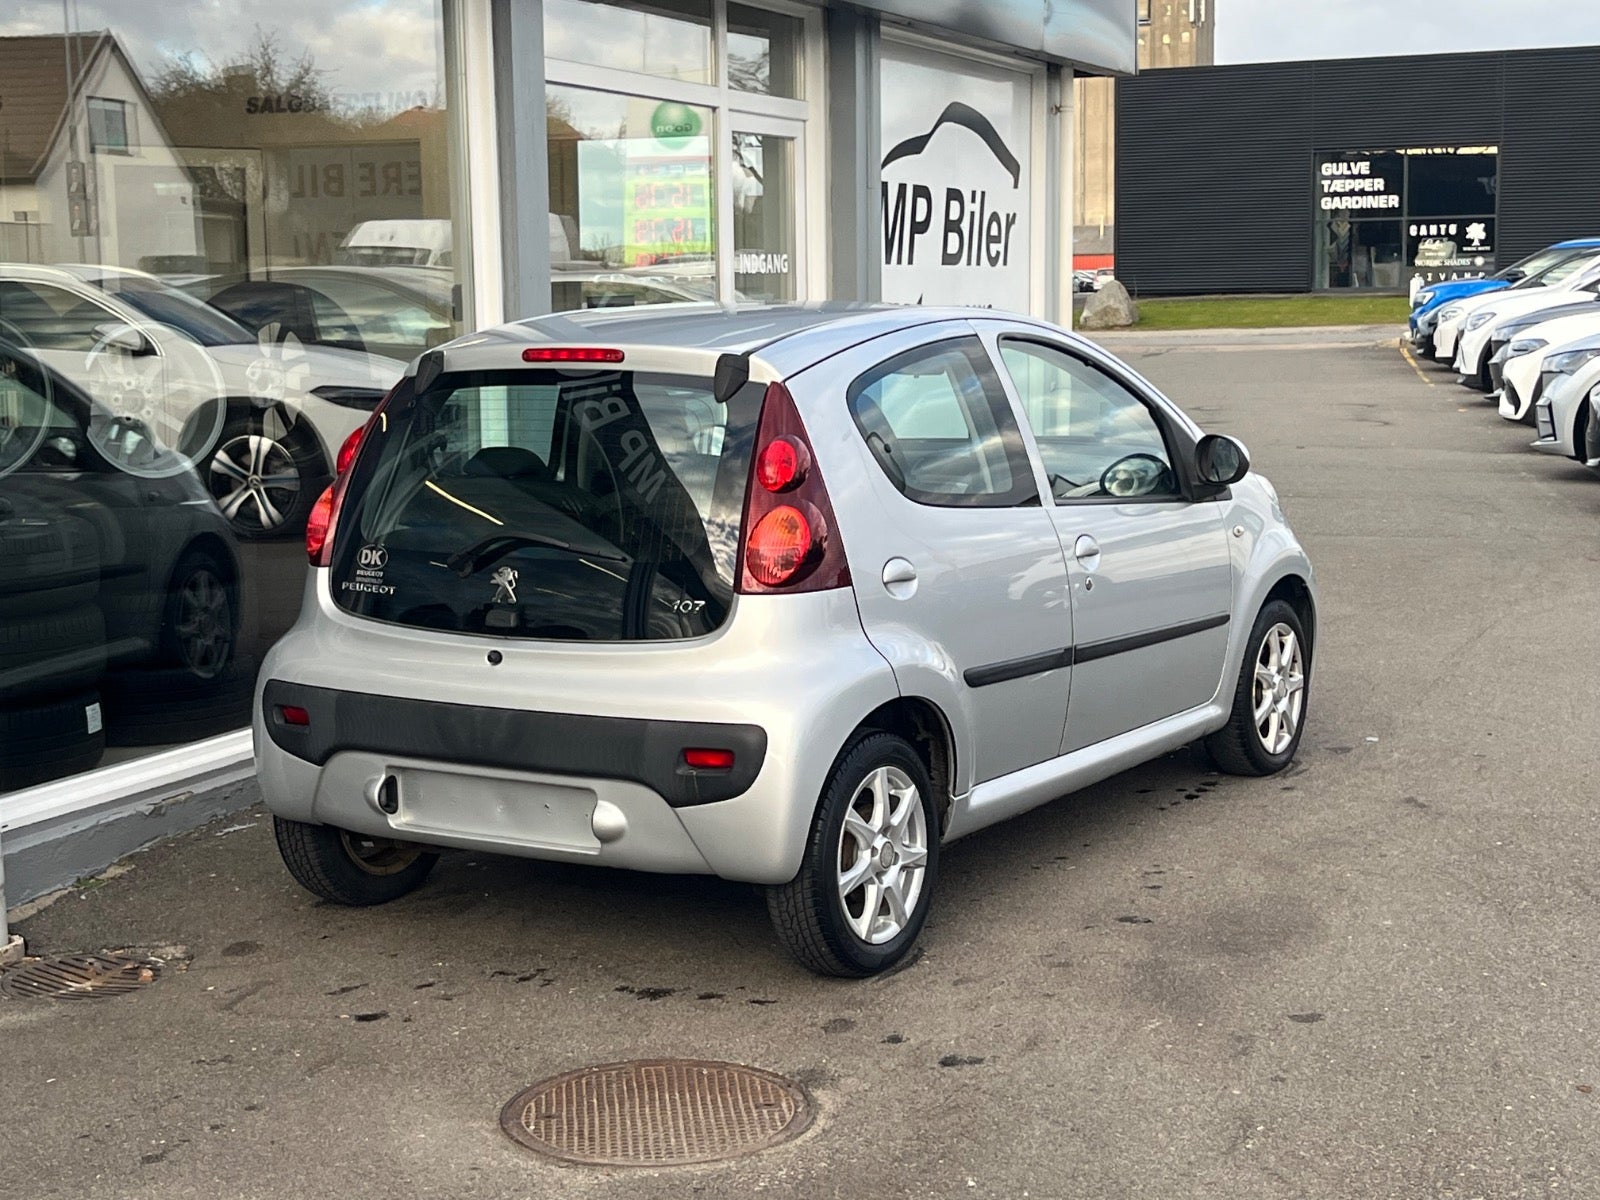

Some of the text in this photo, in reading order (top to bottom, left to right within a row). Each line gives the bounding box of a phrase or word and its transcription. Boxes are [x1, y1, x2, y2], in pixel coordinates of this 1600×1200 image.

[1321, 161, 1370, 176] GULVE
[1321, 178, 1384, 193] TÆPPER
[1321, 195, 1399, 210] GARDINER
[881, 181, 1017, 267] MP Biler
[740, 253, 788, 274] INDGANG
[361, 549, 383, 565] DK
[342, 581, 397, 595] PEUGEOT
[672, 600, 706, 614] 107
